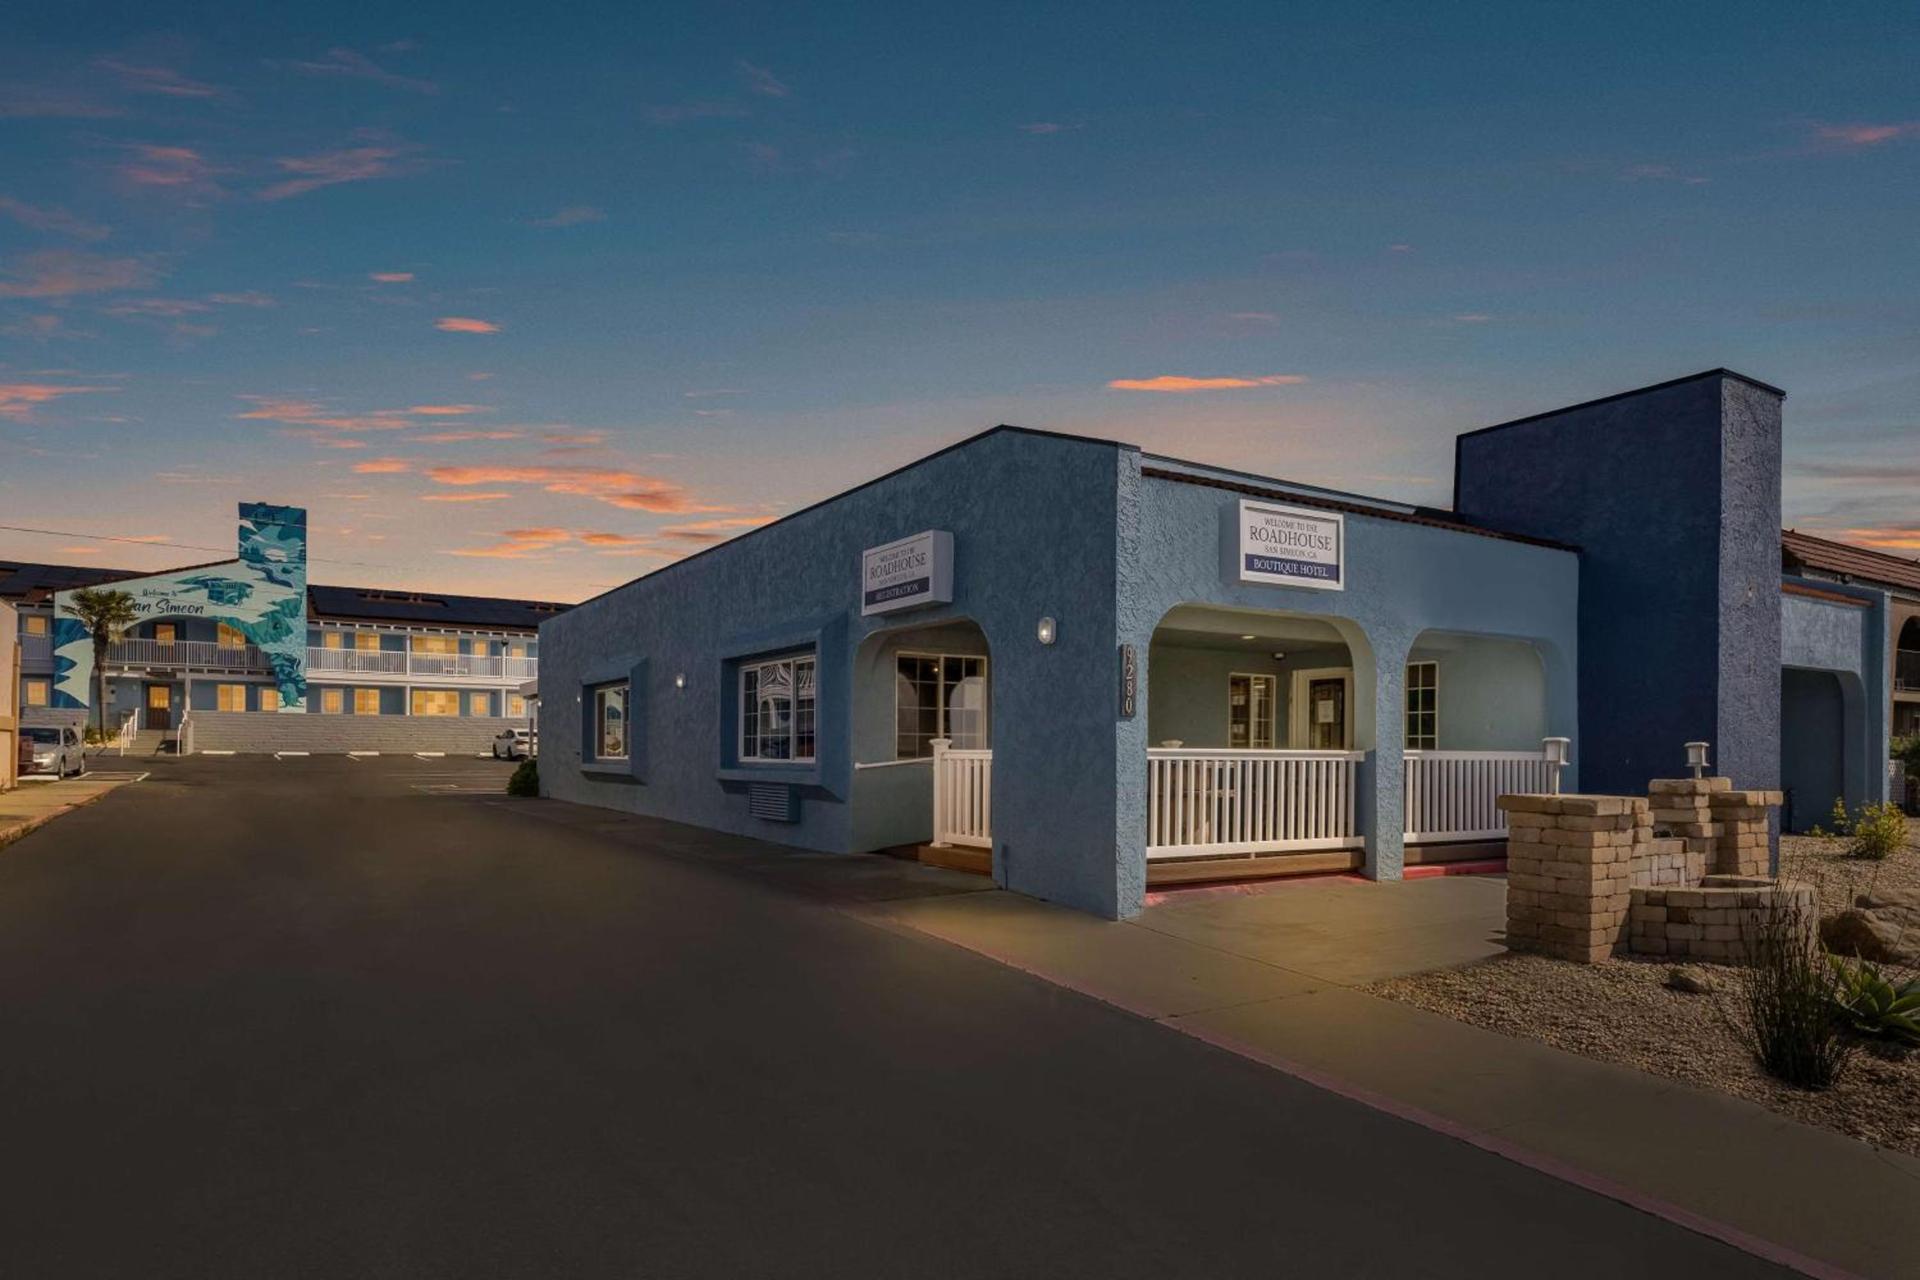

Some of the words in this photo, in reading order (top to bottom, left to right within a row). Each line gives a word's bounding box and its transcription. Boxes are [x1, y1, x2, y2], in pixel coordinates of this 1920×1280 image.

[1249, 526, 1332, 551] ROADHOUSE
[870, 552, 927, 580] ROADHOUSE
[1253, 558, 1299, 575] BOUTIQUE
[1300, 565, 1329, 577] HOTEL
[155, 599, 205, 614] Simeon
[1125, 647, 1133, 714] 9280
